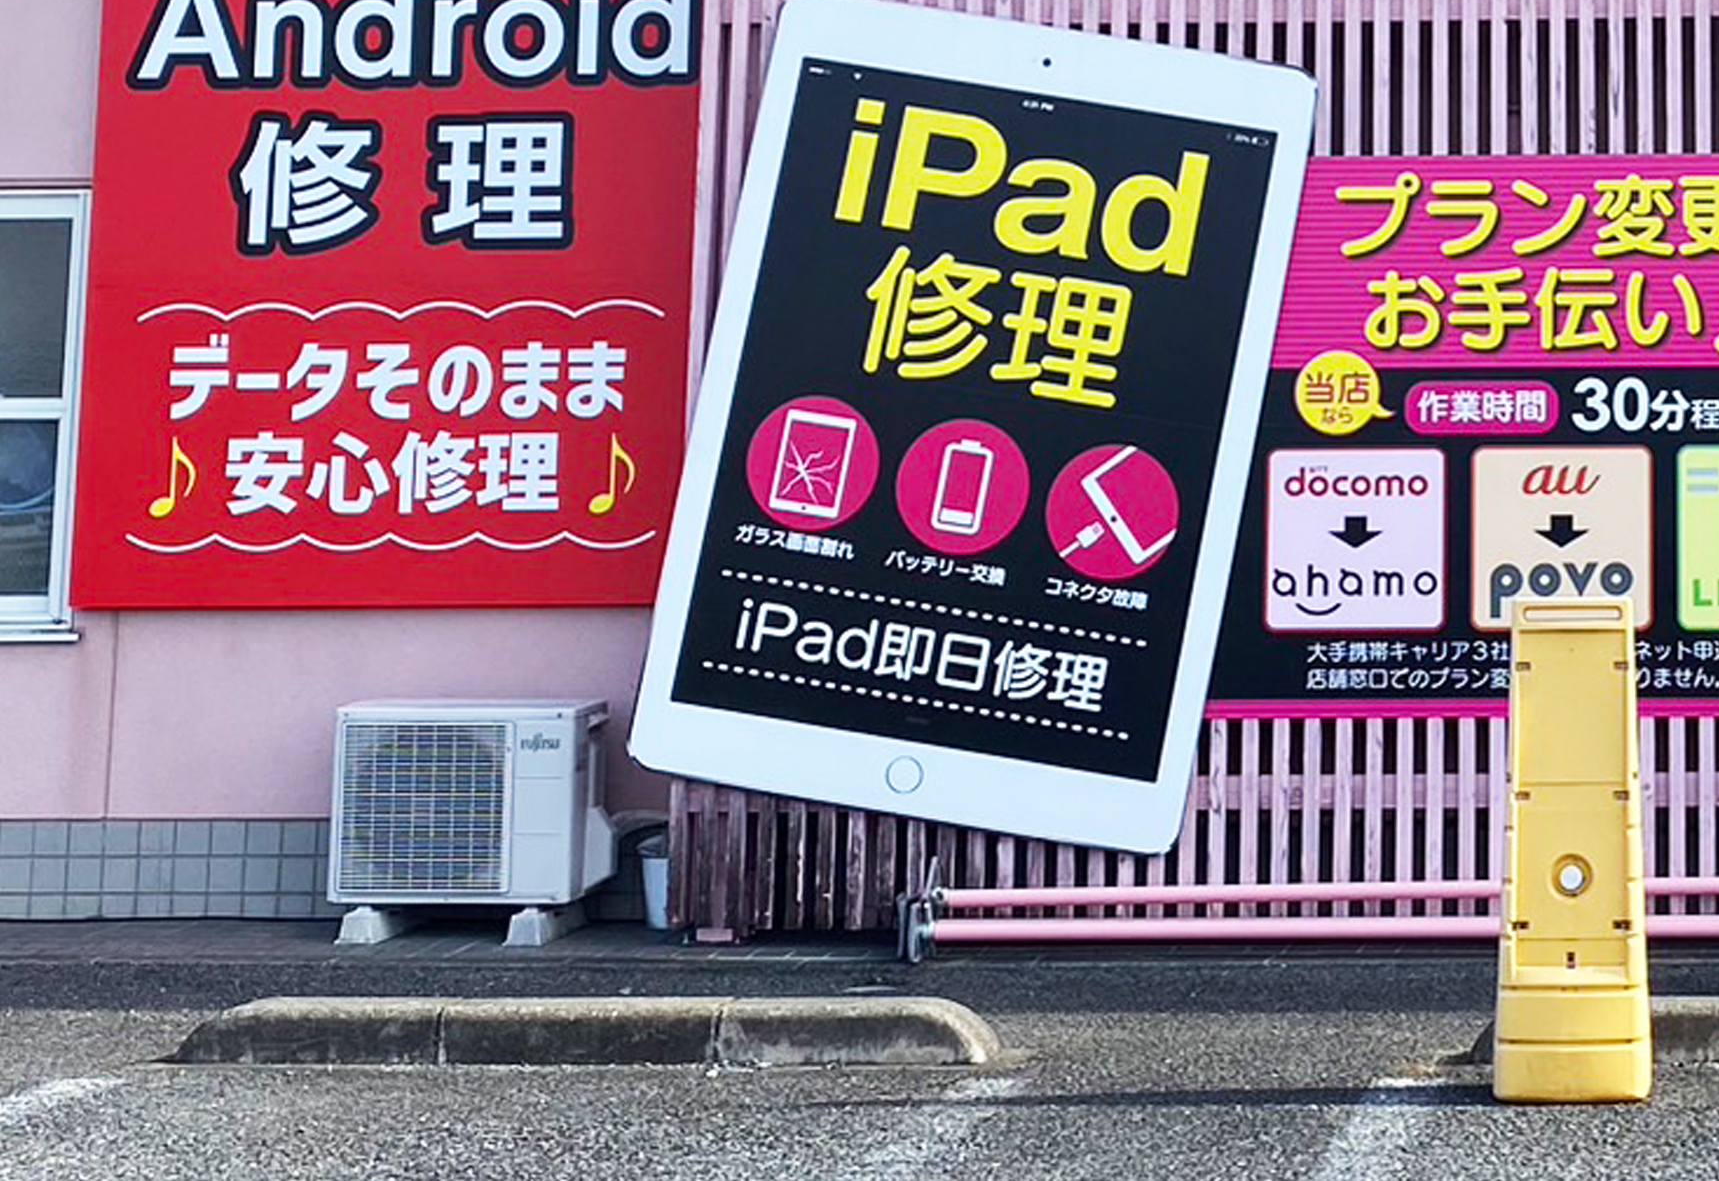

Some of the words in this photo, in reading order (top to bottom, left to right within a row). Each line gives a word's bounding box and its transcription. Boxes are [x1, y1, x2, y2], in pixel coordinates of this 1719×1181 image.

[234, 115, 570, 251] 修理
[834, 97, 1211, 277] iPad
[862, 245, 1133, 409] 修理
[169, 333, 627, 421] データそのまま
[1304, 371, 1371, 404] 当店
[1321, 406, 1353, 424] なら
[1416, 390, 1548, 424] 作業時間
[225, 431, 560, 515] 安心修理
[1284, 467, 1428, 496] docomo
[1522, 464, 1600, 496] au
[884, 549, 1006, 587] バッテリー交換
[1272, 564, 1438, 597] ahamo
[1044, 576, 1149, 611] コネクタ故障
[1490, 561, 1634, 618] povo
[735, 598, 1109, 712] iPad即日修理
